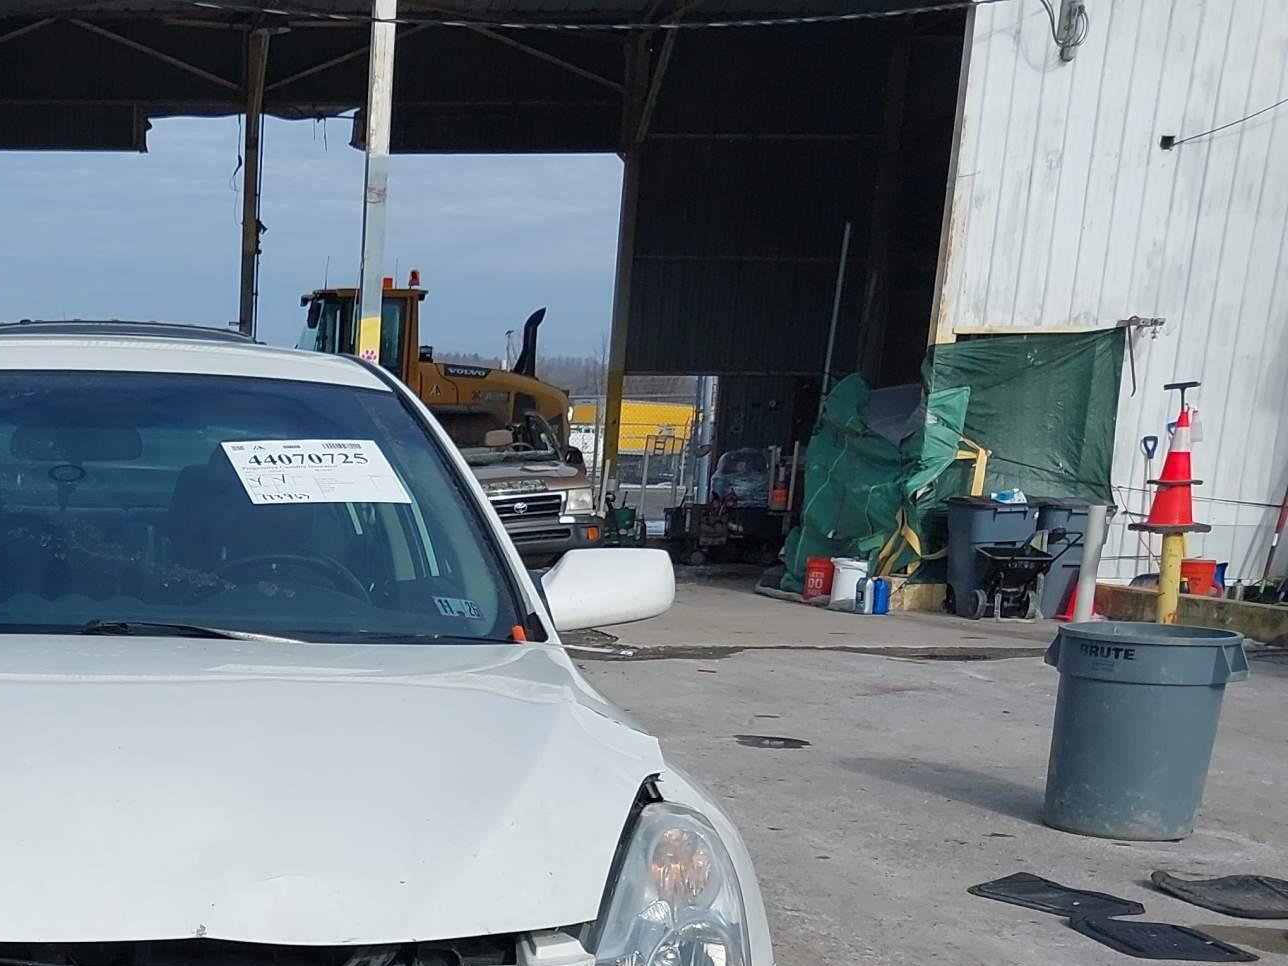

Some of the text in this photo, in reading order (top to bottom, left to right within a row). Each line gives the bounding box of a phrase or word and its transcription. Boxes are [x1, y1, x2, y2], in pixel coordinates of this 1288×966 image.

[448, 368, 486, 376] VOLVO
[248, 453, 369, 465] 44070725
[1080, 643, 1136, 660] BRUTE
